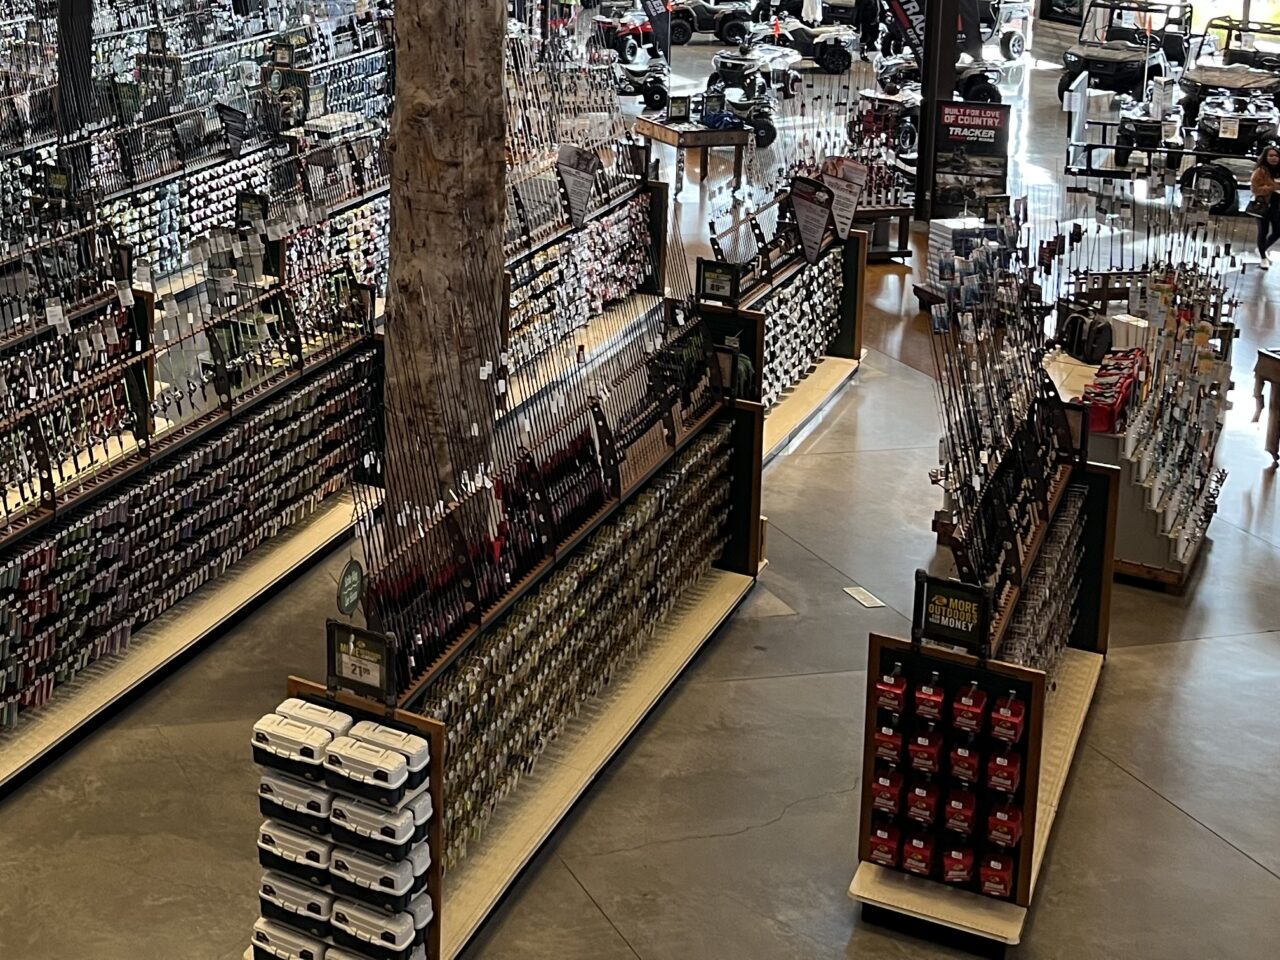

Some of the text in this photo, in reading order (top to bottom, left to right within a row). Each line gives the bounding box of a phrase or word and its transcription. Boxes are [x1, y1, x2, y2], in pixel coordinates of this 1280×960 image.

[906, 28, 920, 45] OFF
[944, 107, 1001, 118] BUILT FOR LOVE
[944, 115, 957, 124] OF
[949, 126, 995, 139] TRACKER
[928, 603, 979, 624] OUTDOORS
[949, 597, 979, 614] MORE
[941, 615, 974, 632] MONEY
